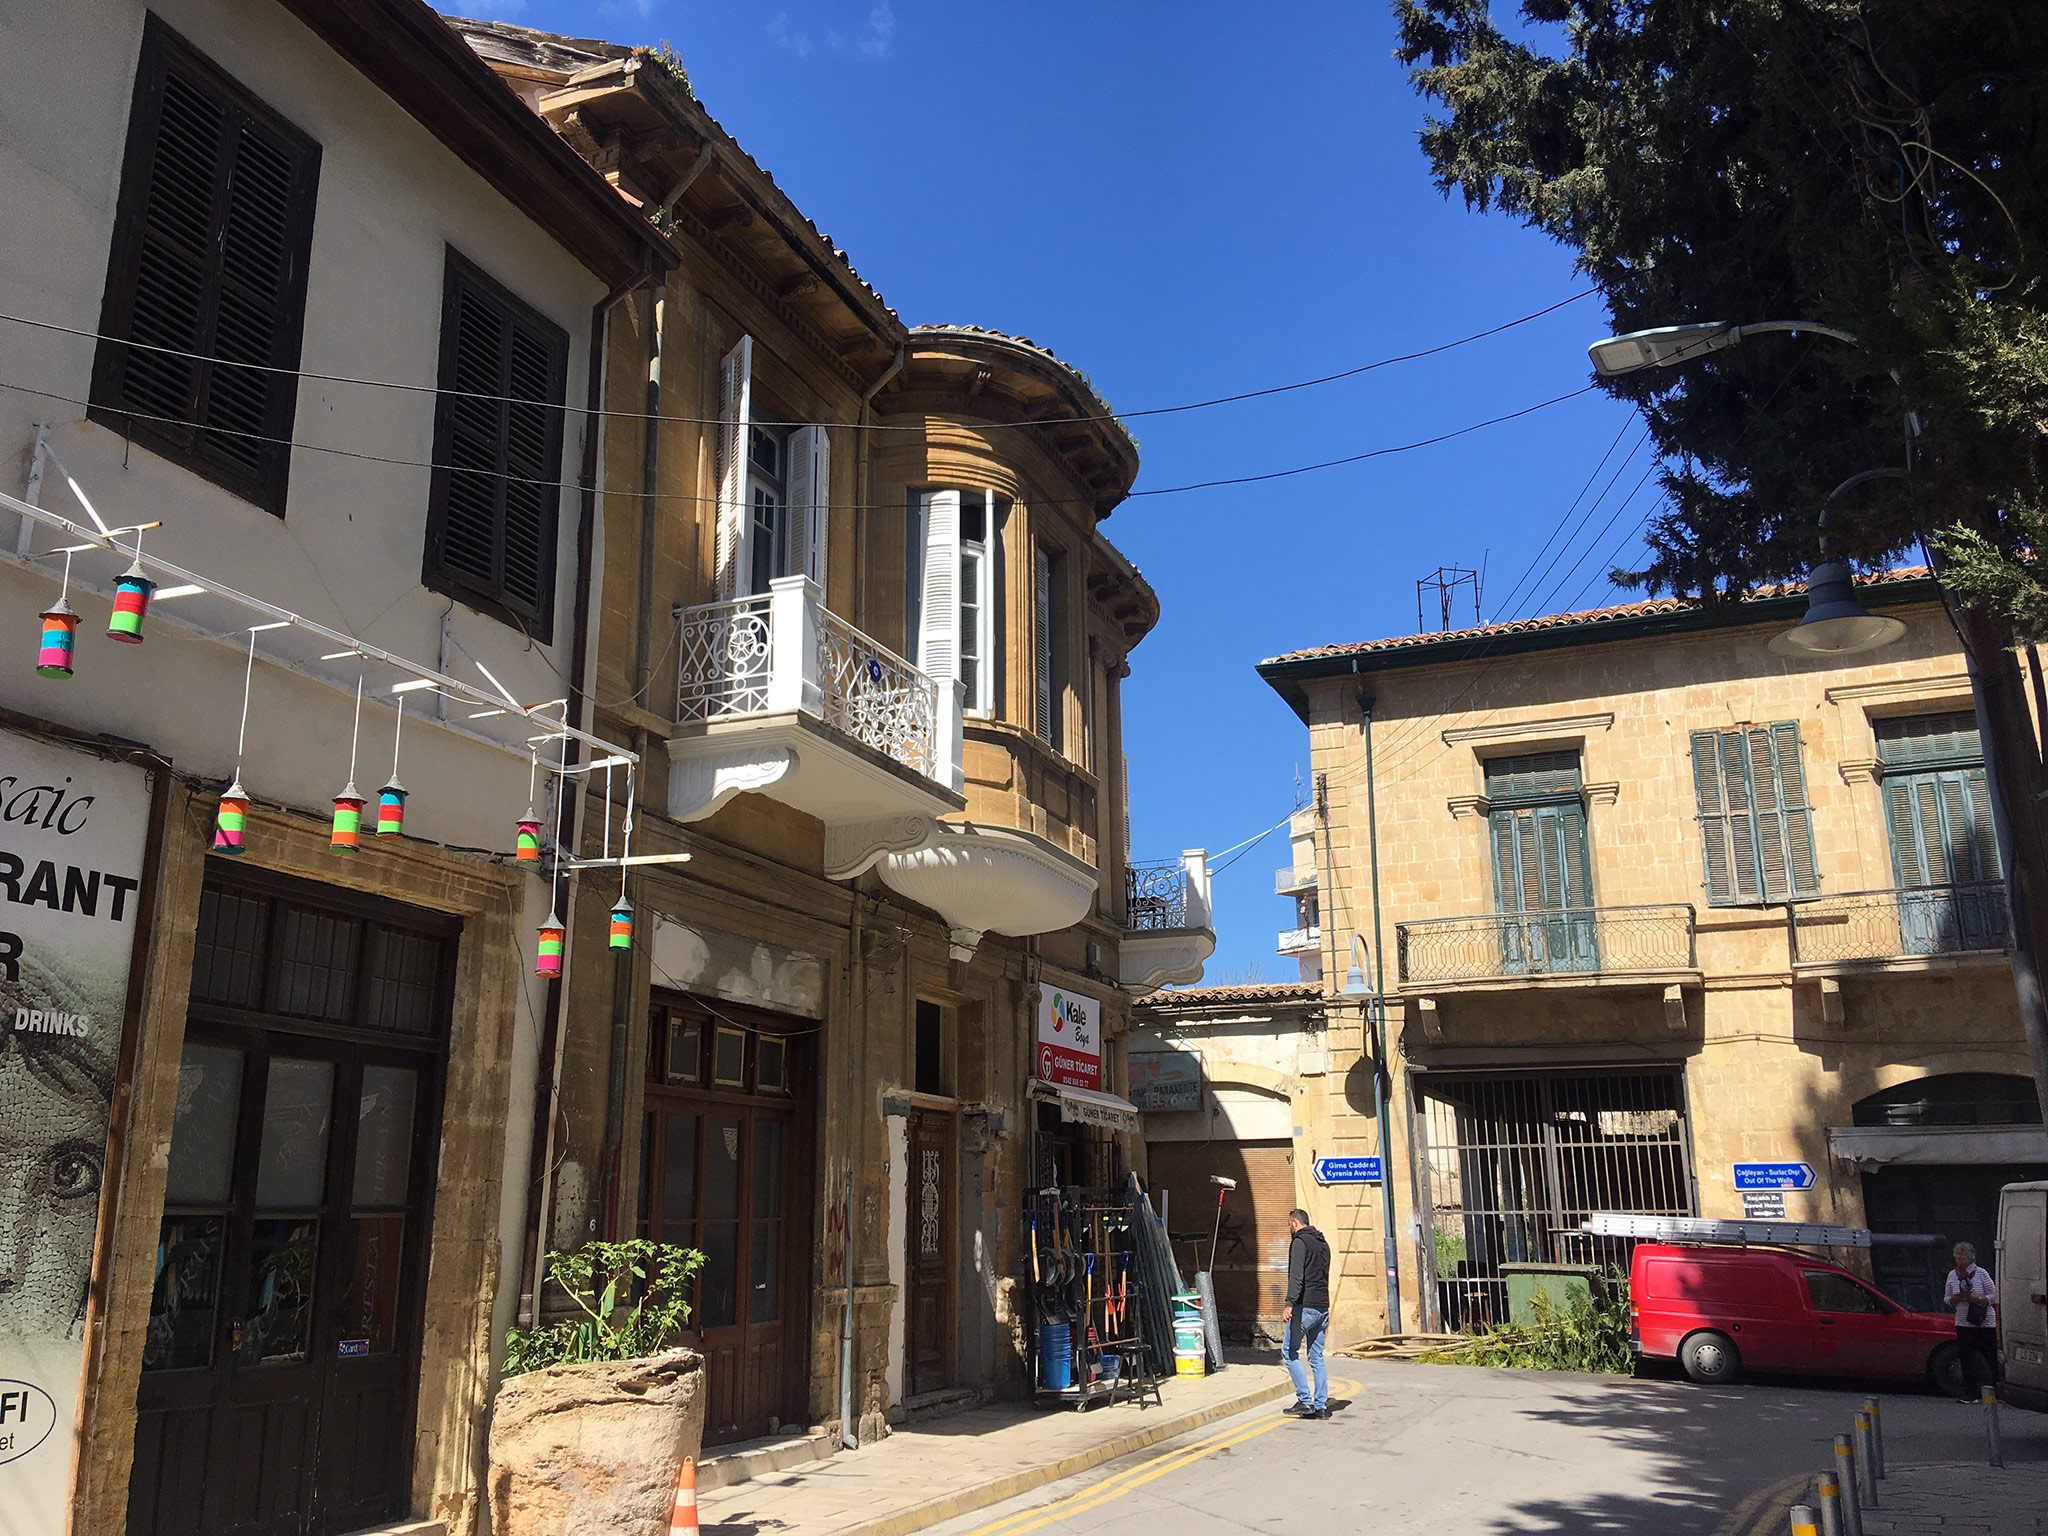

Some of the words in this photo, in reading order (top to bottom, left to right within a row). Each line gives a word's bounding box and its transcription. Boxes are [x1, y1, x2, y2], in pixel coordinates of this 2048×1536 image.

[14, 1007, 90, 1038] DRINKS
[1066, 1001, 1087, 1026] Kale
[1055, 1055, 1074, 1071] GÜNER
[1075, 1059, 1098, 1076] TİCARET
[1326, 1170, 1352, 1178] Kyrenia
[1353, 1169, 1379, 1177] Avenue
[1348, 1161, 1376, 1169] Caddesi
[589, 1218, 597, 1232] 6
[0, 1391, 28, 1425] FI
